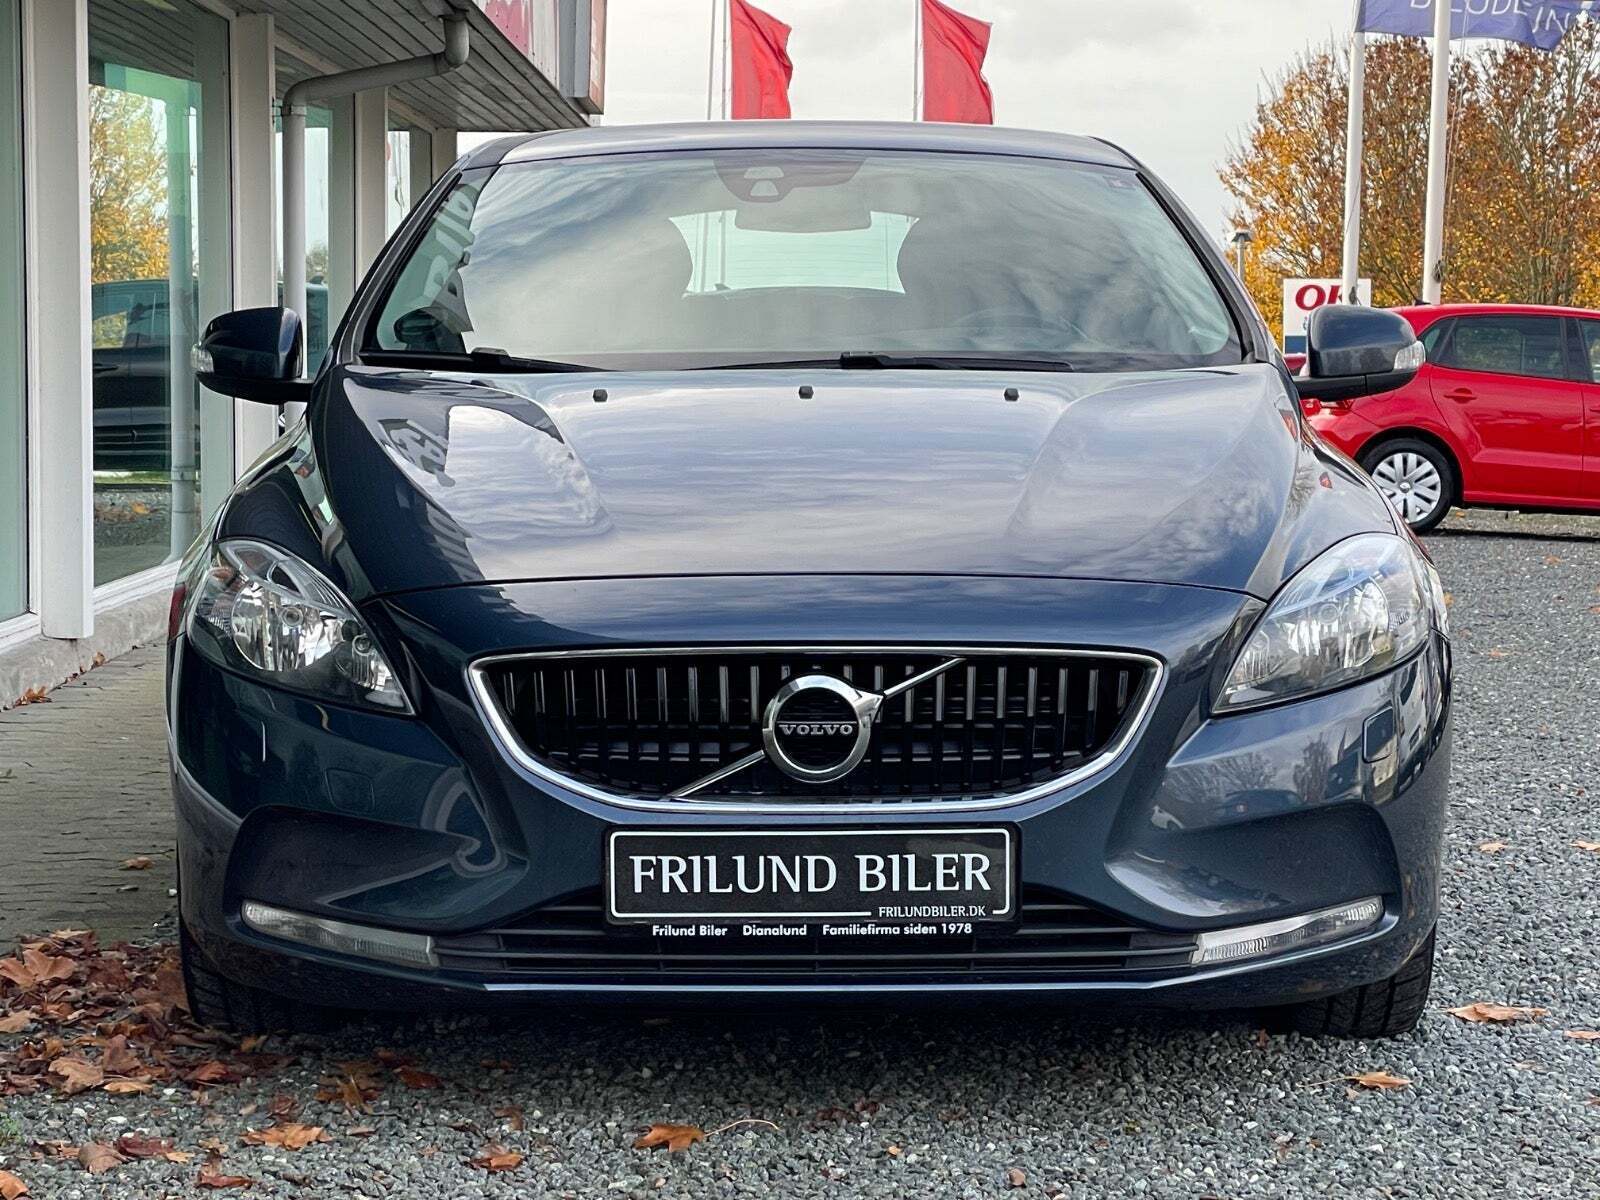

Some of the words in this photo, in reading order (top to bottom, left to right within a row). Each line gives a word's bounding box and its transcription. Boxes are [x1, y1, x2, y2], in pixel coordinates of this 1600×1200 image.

[778, 724, 853, 735] VOLVO
[629, 855, 837, 894] FRILUND
[854, 853, 992, 892] BILER
[878, 905, 987, 918] FRILUNDBILER.DK
[652, 924, 696, 937] Frilund
[699, 924, 728, 937] Biler
[742, 924, 807, 937] Dianalund
[822, 923, 901, 936] Familiefirma
[903, 922, 937, 935] siden
[941, 922, 973, 935] 1978
